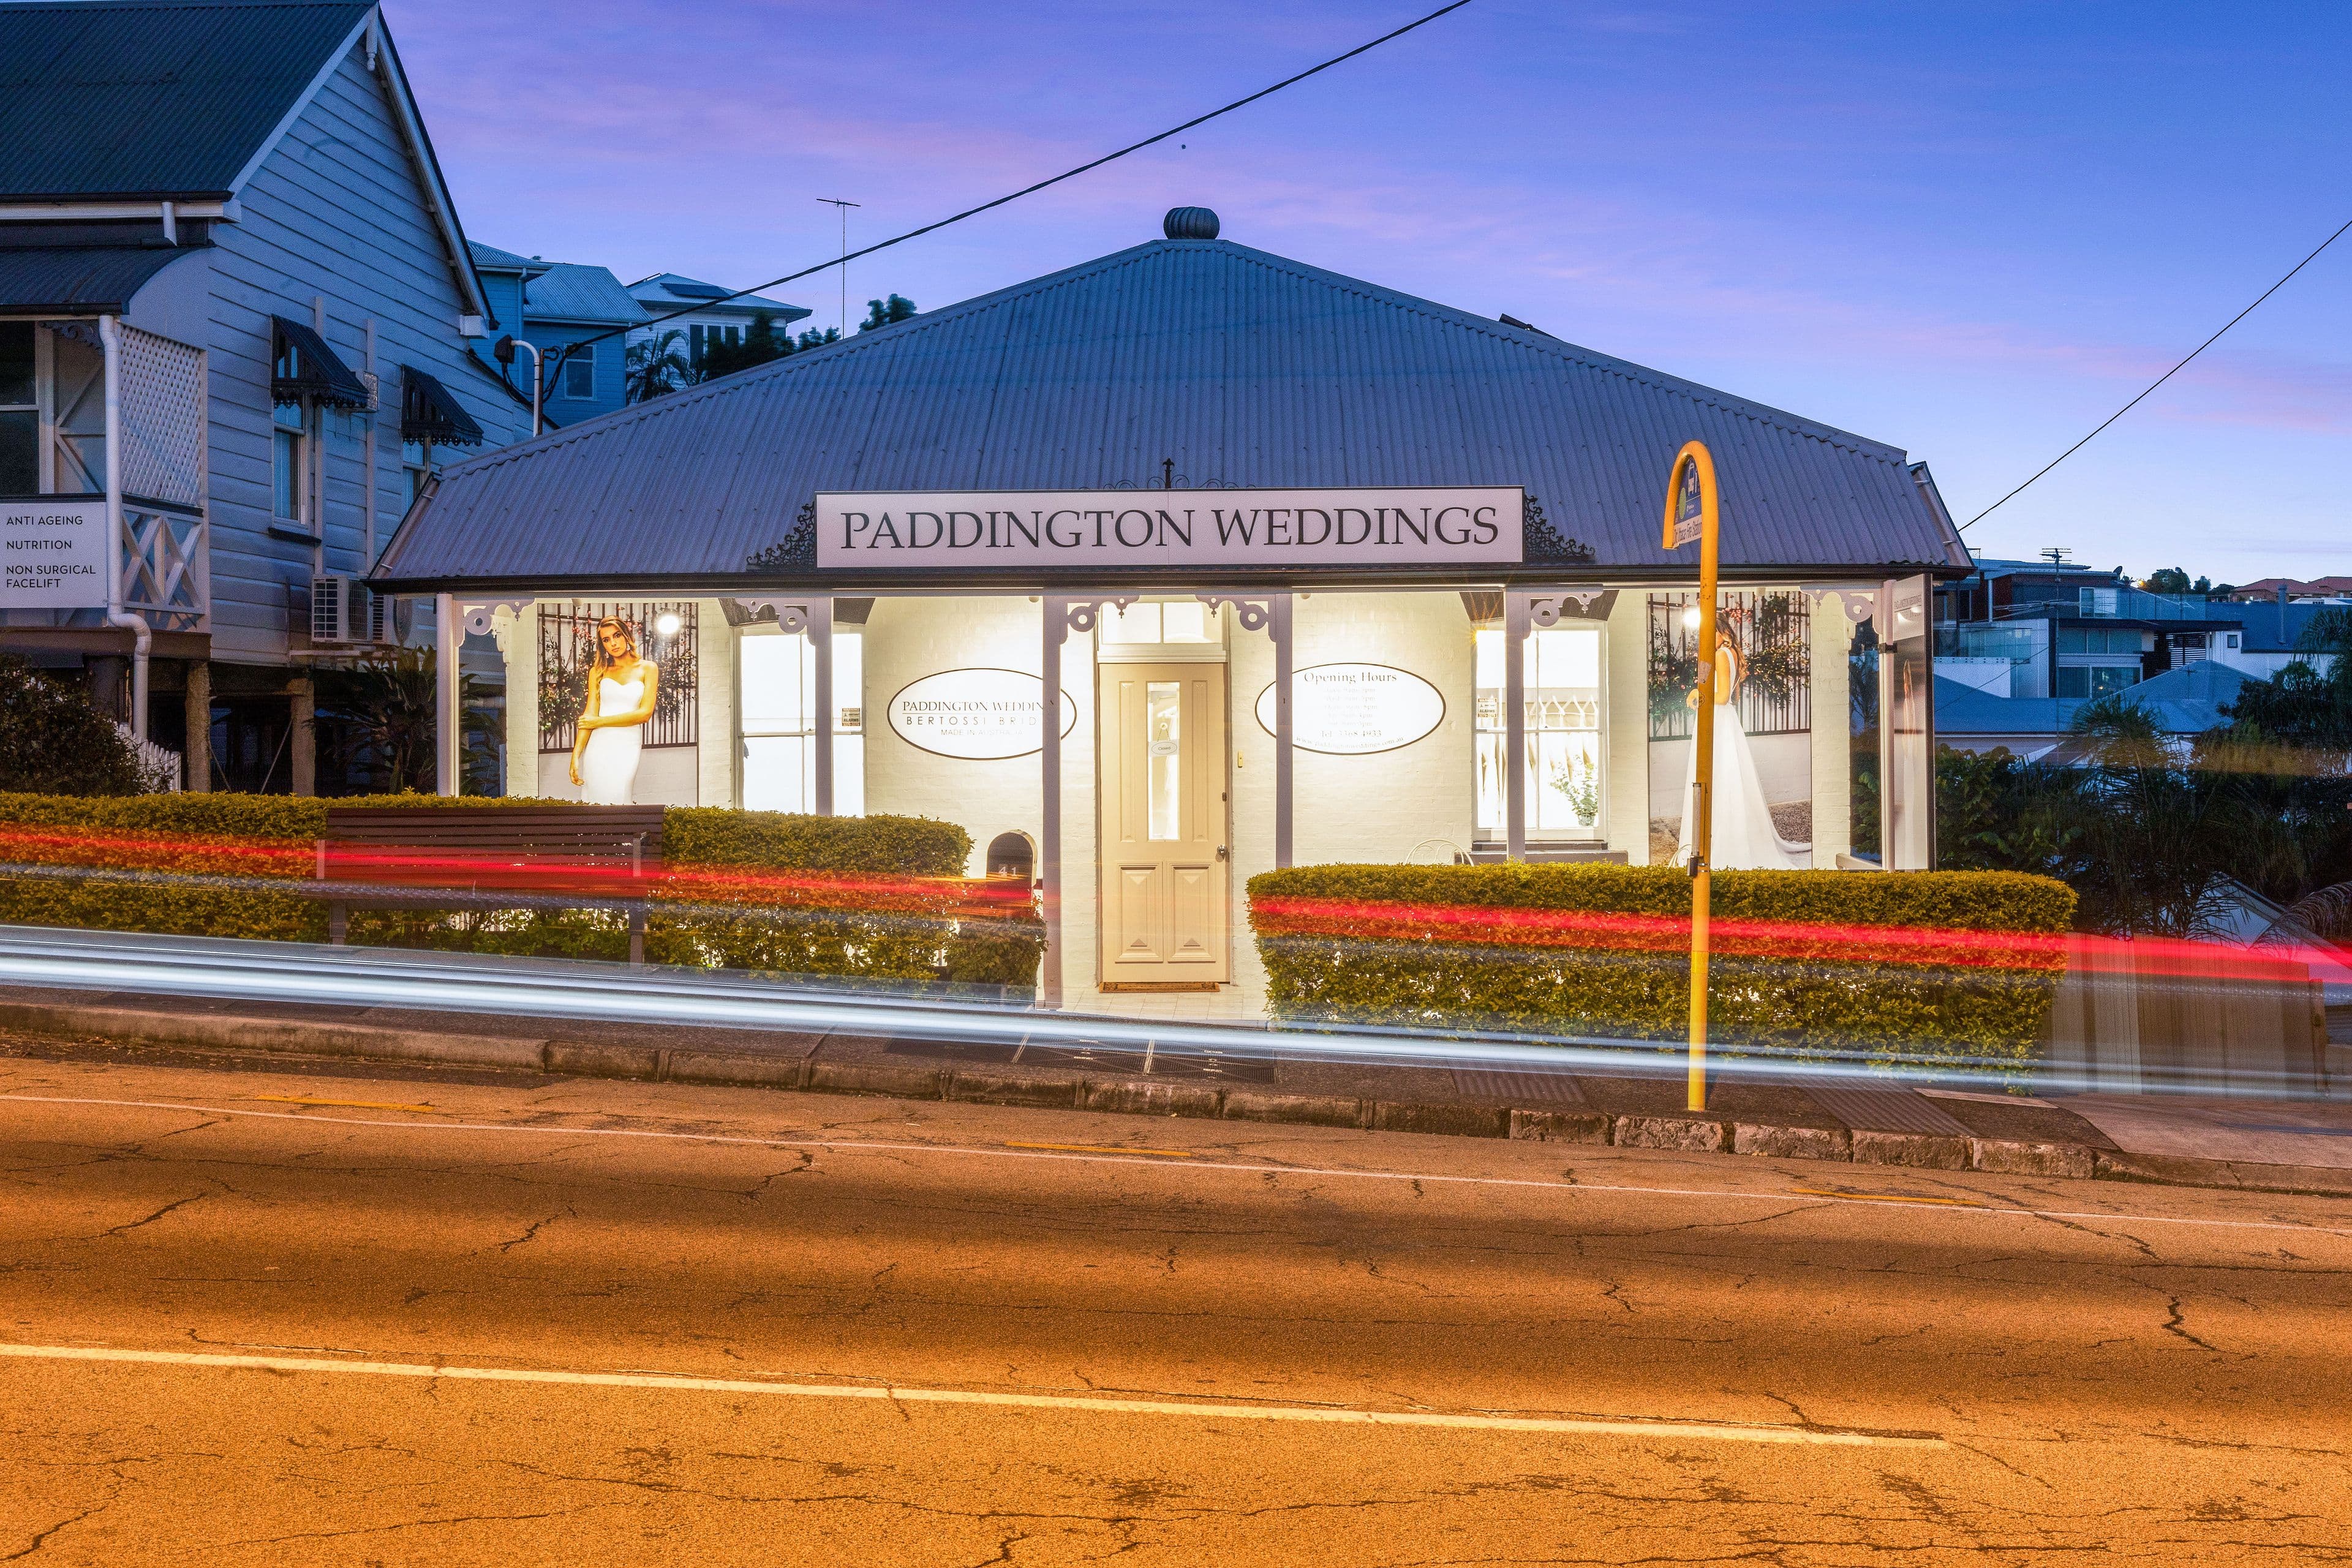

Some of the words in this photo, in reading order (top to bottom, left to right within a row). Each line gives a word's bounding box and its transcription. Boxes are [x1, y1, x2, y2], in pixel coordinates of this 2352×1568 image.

[6, 516, 34, 526] ANTI
[37, 515, 83, 526] AGEING
[841, 510, 1195, 549] PADDINGTON
[1211, 507, 1498, 546] WEDDINGS
[7, 540, 72, 550] NUTRITION
[6, 565, 32, 575] NON
[36, 564, 96, 575] SURGICAL
[7, 578, 61, 588] FACELIFT
[1304, 672, 1355, 685] Opening
[1362, 672, 1397, 682] Hours
[902, 701, 987, 711] PADDINGTON
[992, 701, 1042, 711] WEDDIN
[907, 716, 986, 725] BERTOSSI
[999, 716, 1037, 725] BRID
[998, 867, 1017, 876] 41
